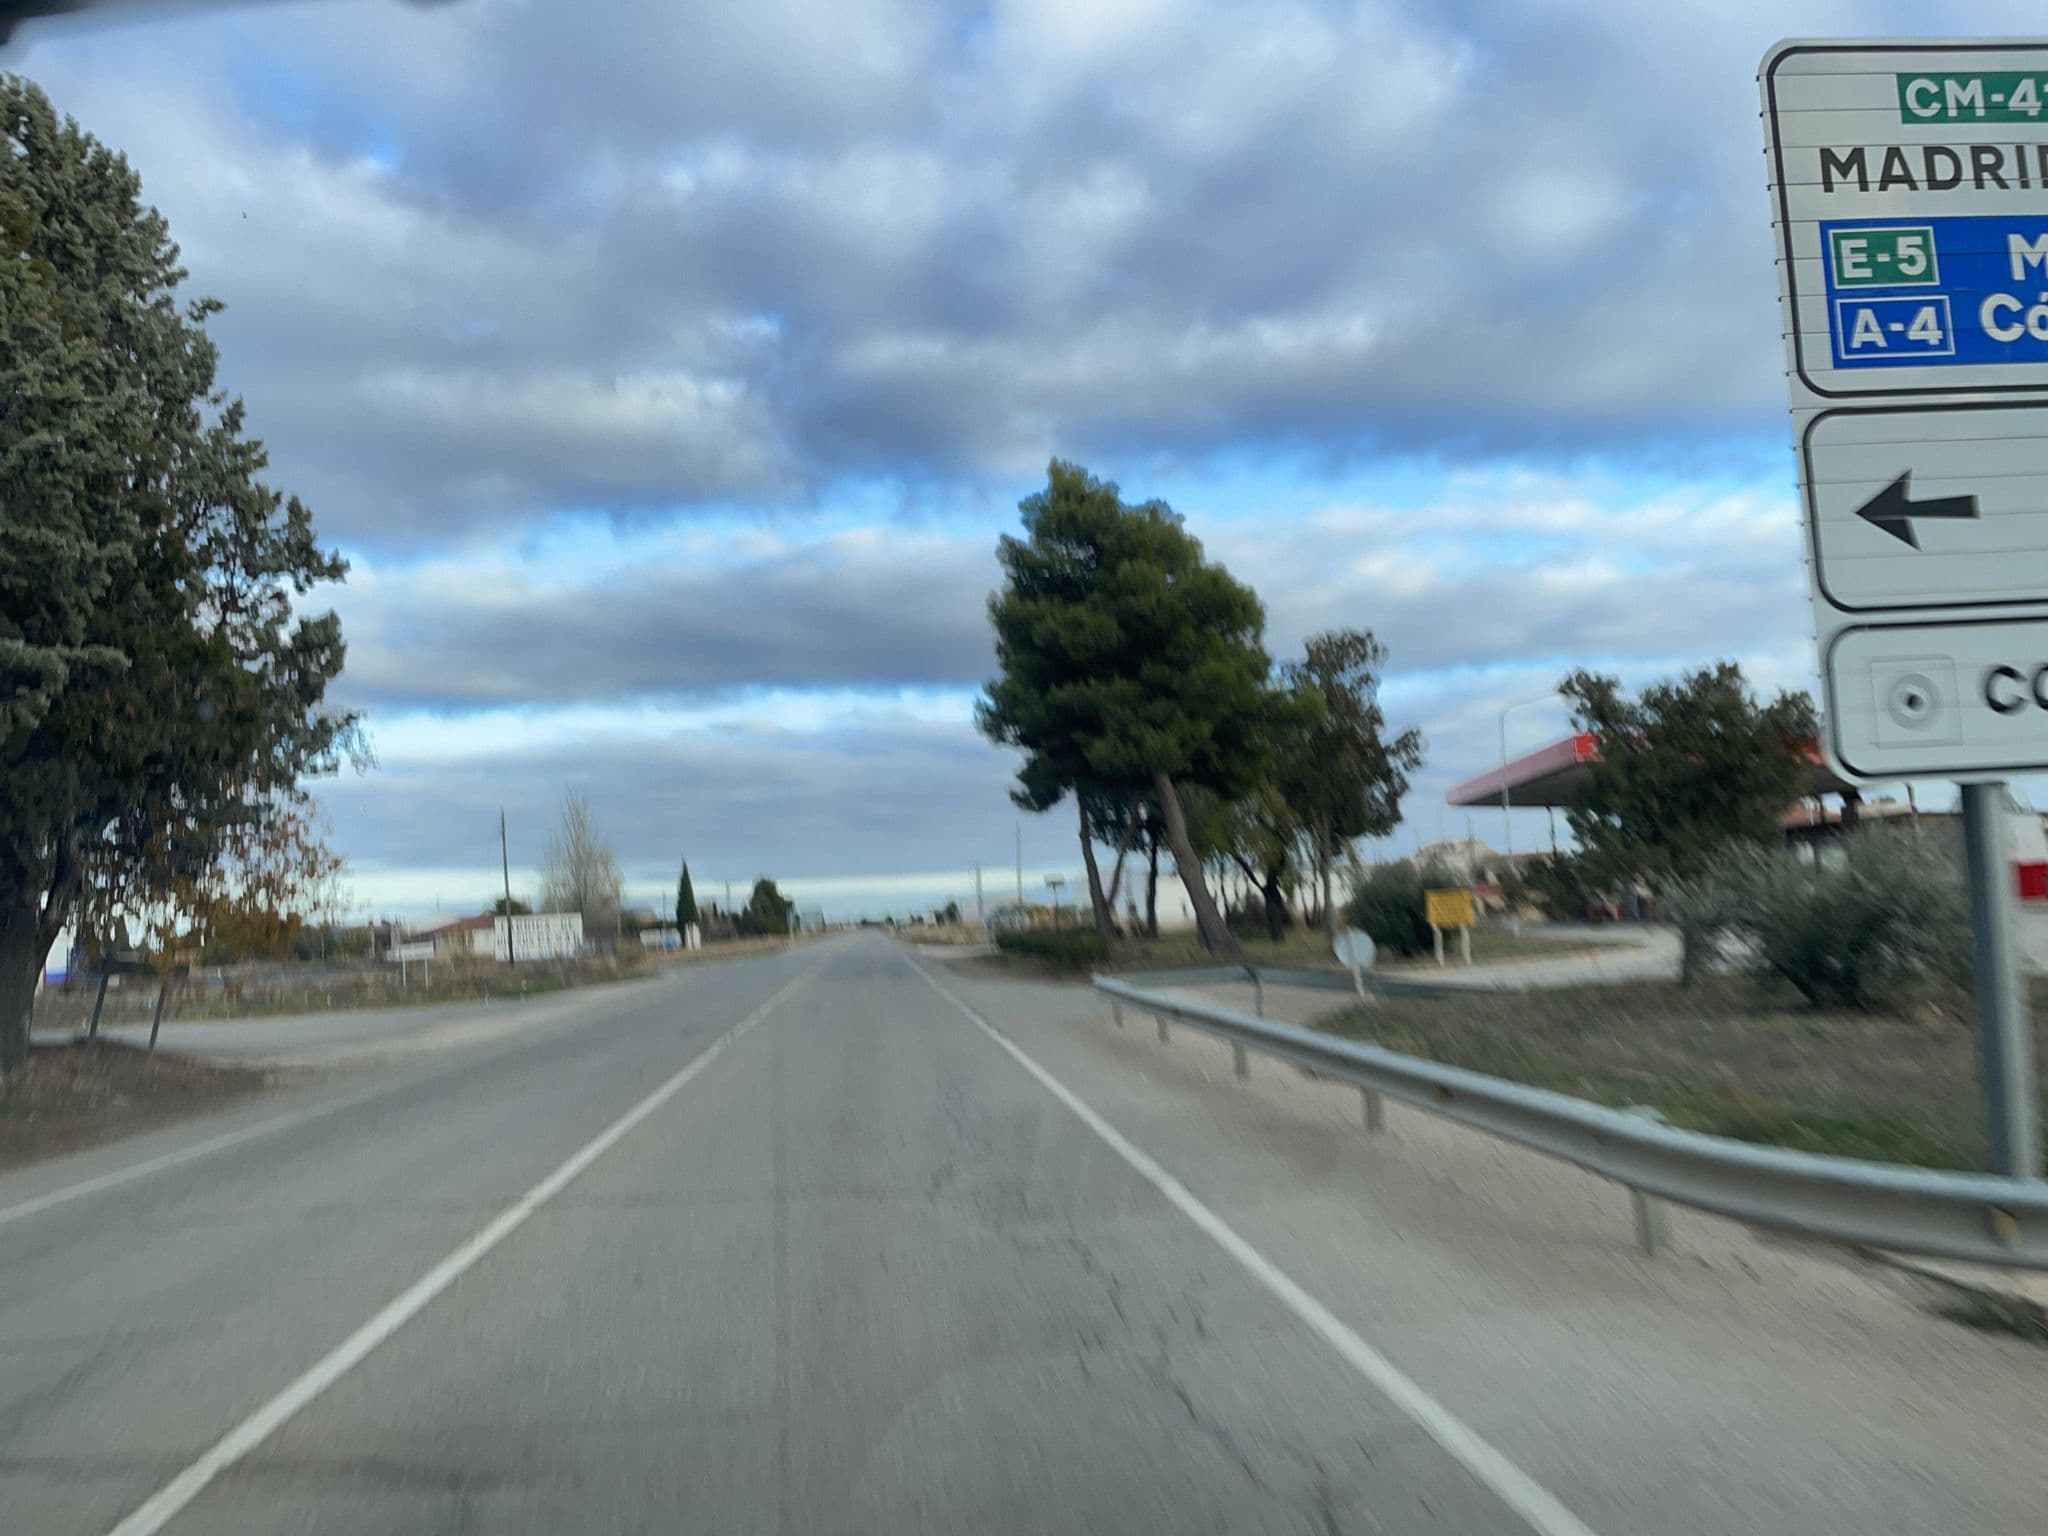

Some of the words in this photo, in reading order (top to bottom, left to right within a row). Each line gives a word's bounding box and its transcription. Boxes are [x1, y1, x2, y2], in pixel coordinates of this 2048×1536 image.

[1905, 78, 2048, 117] CM-4
[1820, 144, 2048, 193] MADRI
[1840, 236, 1928, 279] E-5
[1851, 306, 1944, 349] A-4
